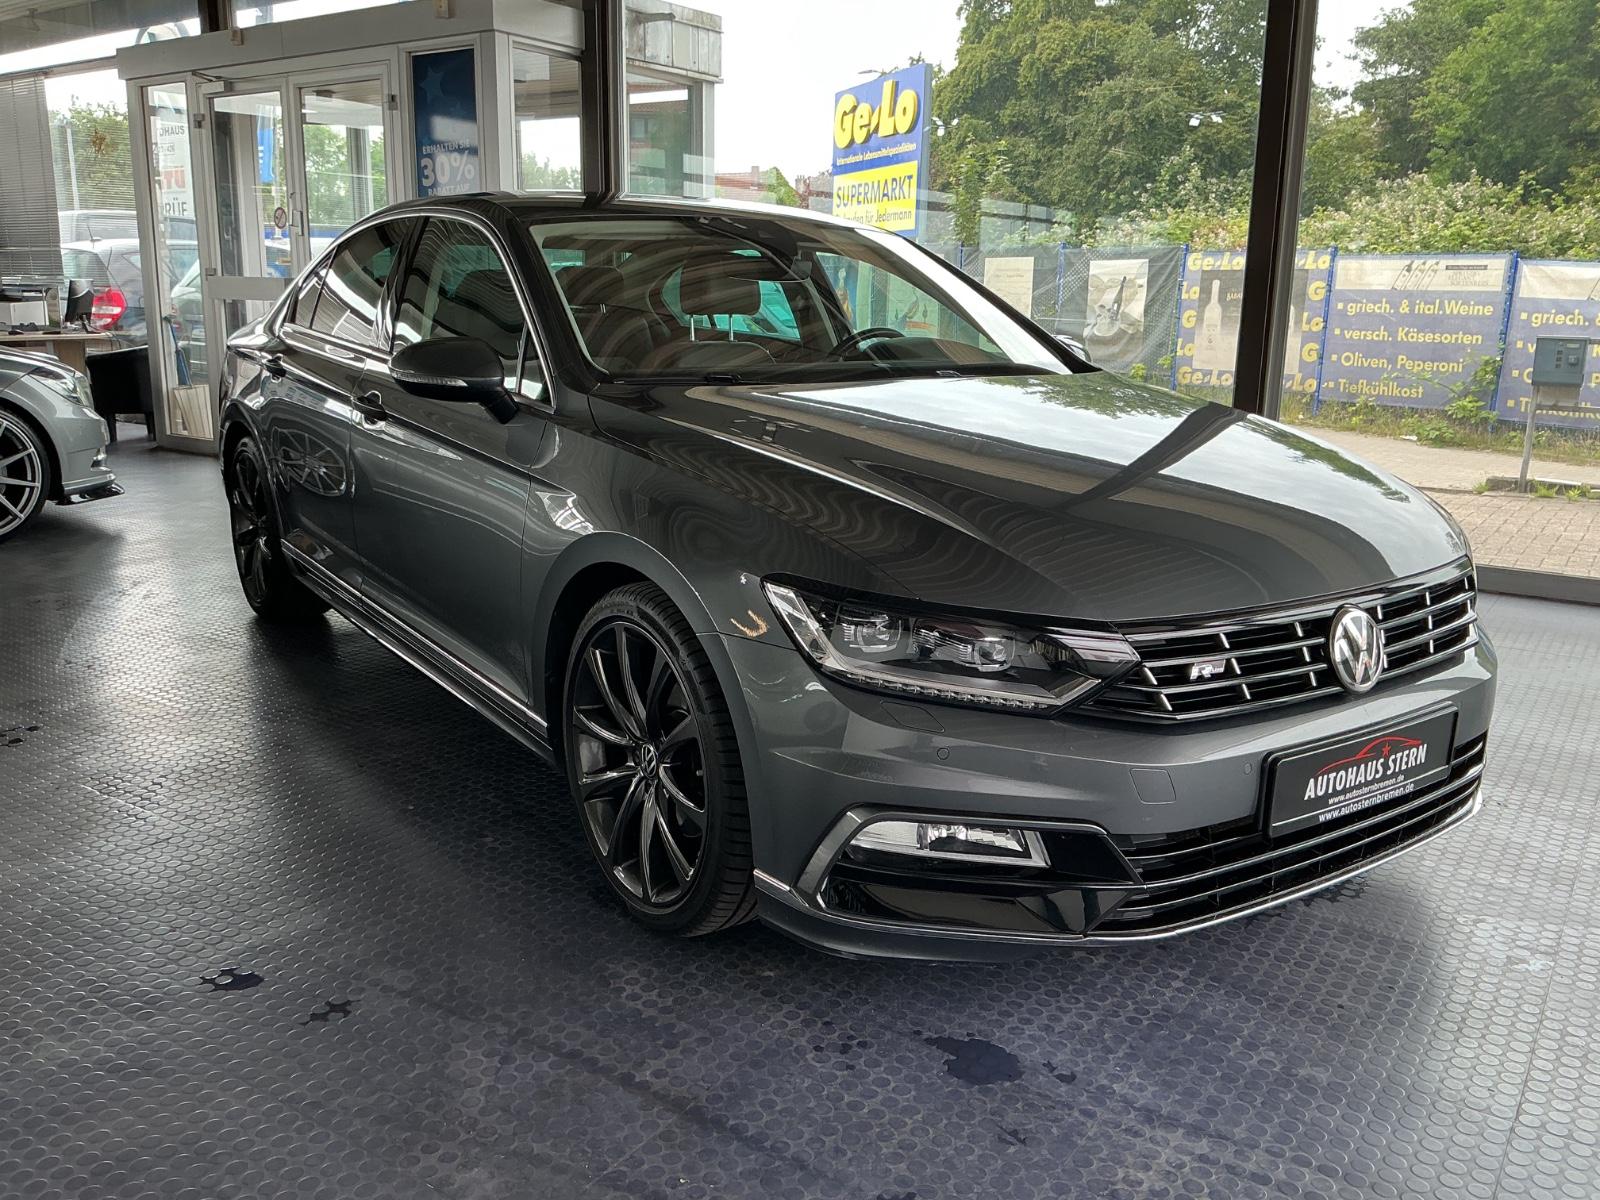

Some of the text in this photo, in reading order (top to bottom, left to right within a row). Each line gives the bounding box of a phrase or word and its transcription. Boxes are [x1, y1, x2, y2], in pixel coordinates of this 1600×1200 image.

[422, 142, 458, 154] ERHALTEN
[420, 150, 475, 187] 30%
[836, 175, 914, 209] SUPERMARKT
[875, 208, 912, 223] Jedermann
[1346, 298, 1394, 316] griech.
[1399, 299, 1410, 314] &
[1531, 308, 1590, 327] griech.
[1343, 325, 1483, 345] versch. Käsesorten
[1340, 351, 1464, 373] Oliven, Peperoni
[1303, 743, 1428, 801] AUTOHAUS STERN
[1328, 774, 1405, 805] www.autosternbremen.de
[1318, 782, 1415, 823] www.autosternbremen.de
